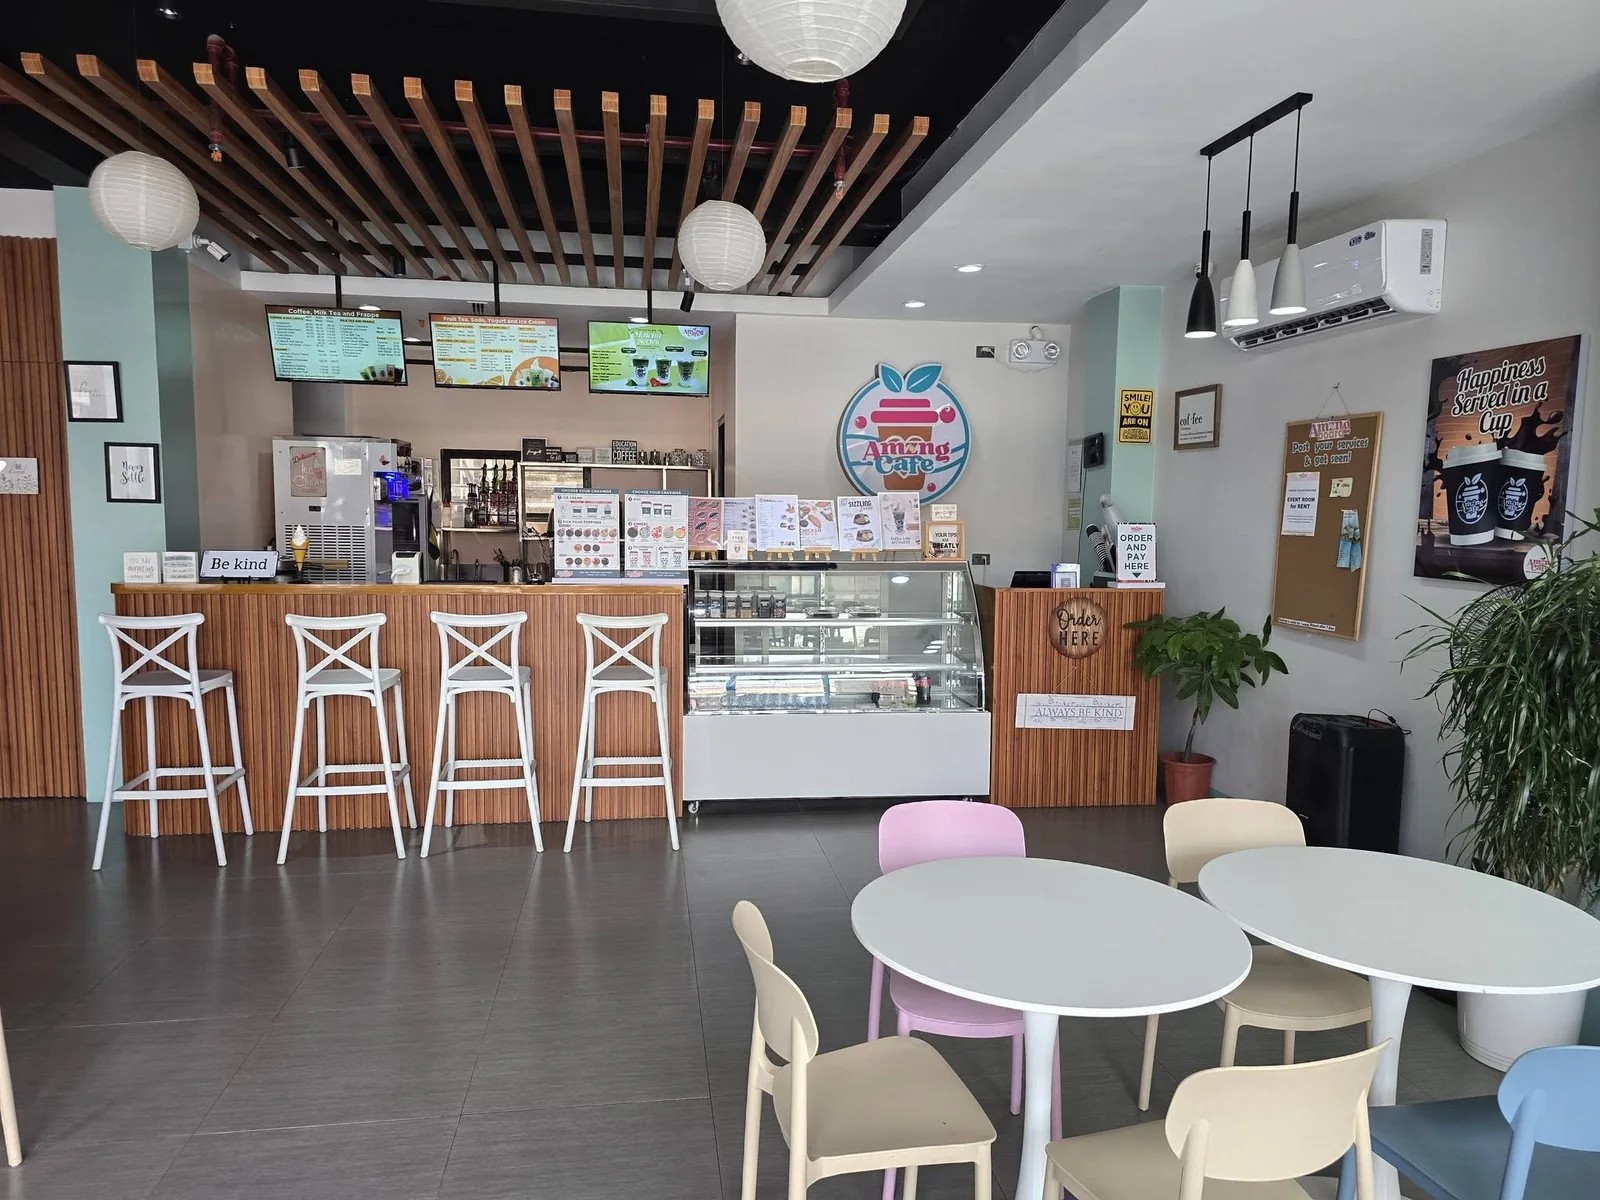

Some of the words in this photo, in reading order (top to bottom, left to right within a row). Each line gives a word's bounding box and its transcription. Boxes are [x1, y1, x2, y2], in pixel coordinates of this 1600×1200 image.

[288, 308, 312, 316] Coffee,
[356, 311, 379, 319] Frappe
[1457, 356, 1546, 395] Happiness
[1124, 394, 1151, 402] SMILE!
[1451, 383, 1510, 417] Served
[1510, 381, 1531, 406] in
[1533, 380, 1549, 401] a
[1137, 418, 1149, 426] ON
[1479, 409, 1514, 439] Cup
[1292, 441, 1310, 453] Post
[1315, 441, 1333, 453] your
[1337, 437, 1368, 449] services
[613, 450, 637, 461] COFFEE
[862, 441, 950, 463] Amzng
[874, 455, 934, 474] Cafe
[1304, 456, 1312, 467] &
[1314, 454, 1328, 466] get
[1331, 452, 1352, 464] seen!
[120, 471, 146, 485] Settle
[848, 500, 872, 508] SIZZLING
[1120, 534, 1153, 542] ORDER
[1126, 543, 1147, 551] AND
[210, 557, 230, 570] Be
[233, 557, 268, 570] kind
[1124, 562, 1149, 570] HERE
[1057, 608, 1101, 630] Order
[1059, 631, 1099, 646] HERE
[1035, 707, 1075, 717] ALWAYS
[1078, 708, 1091, 717] BE
[1094, 708, 1122, 717] KIND
